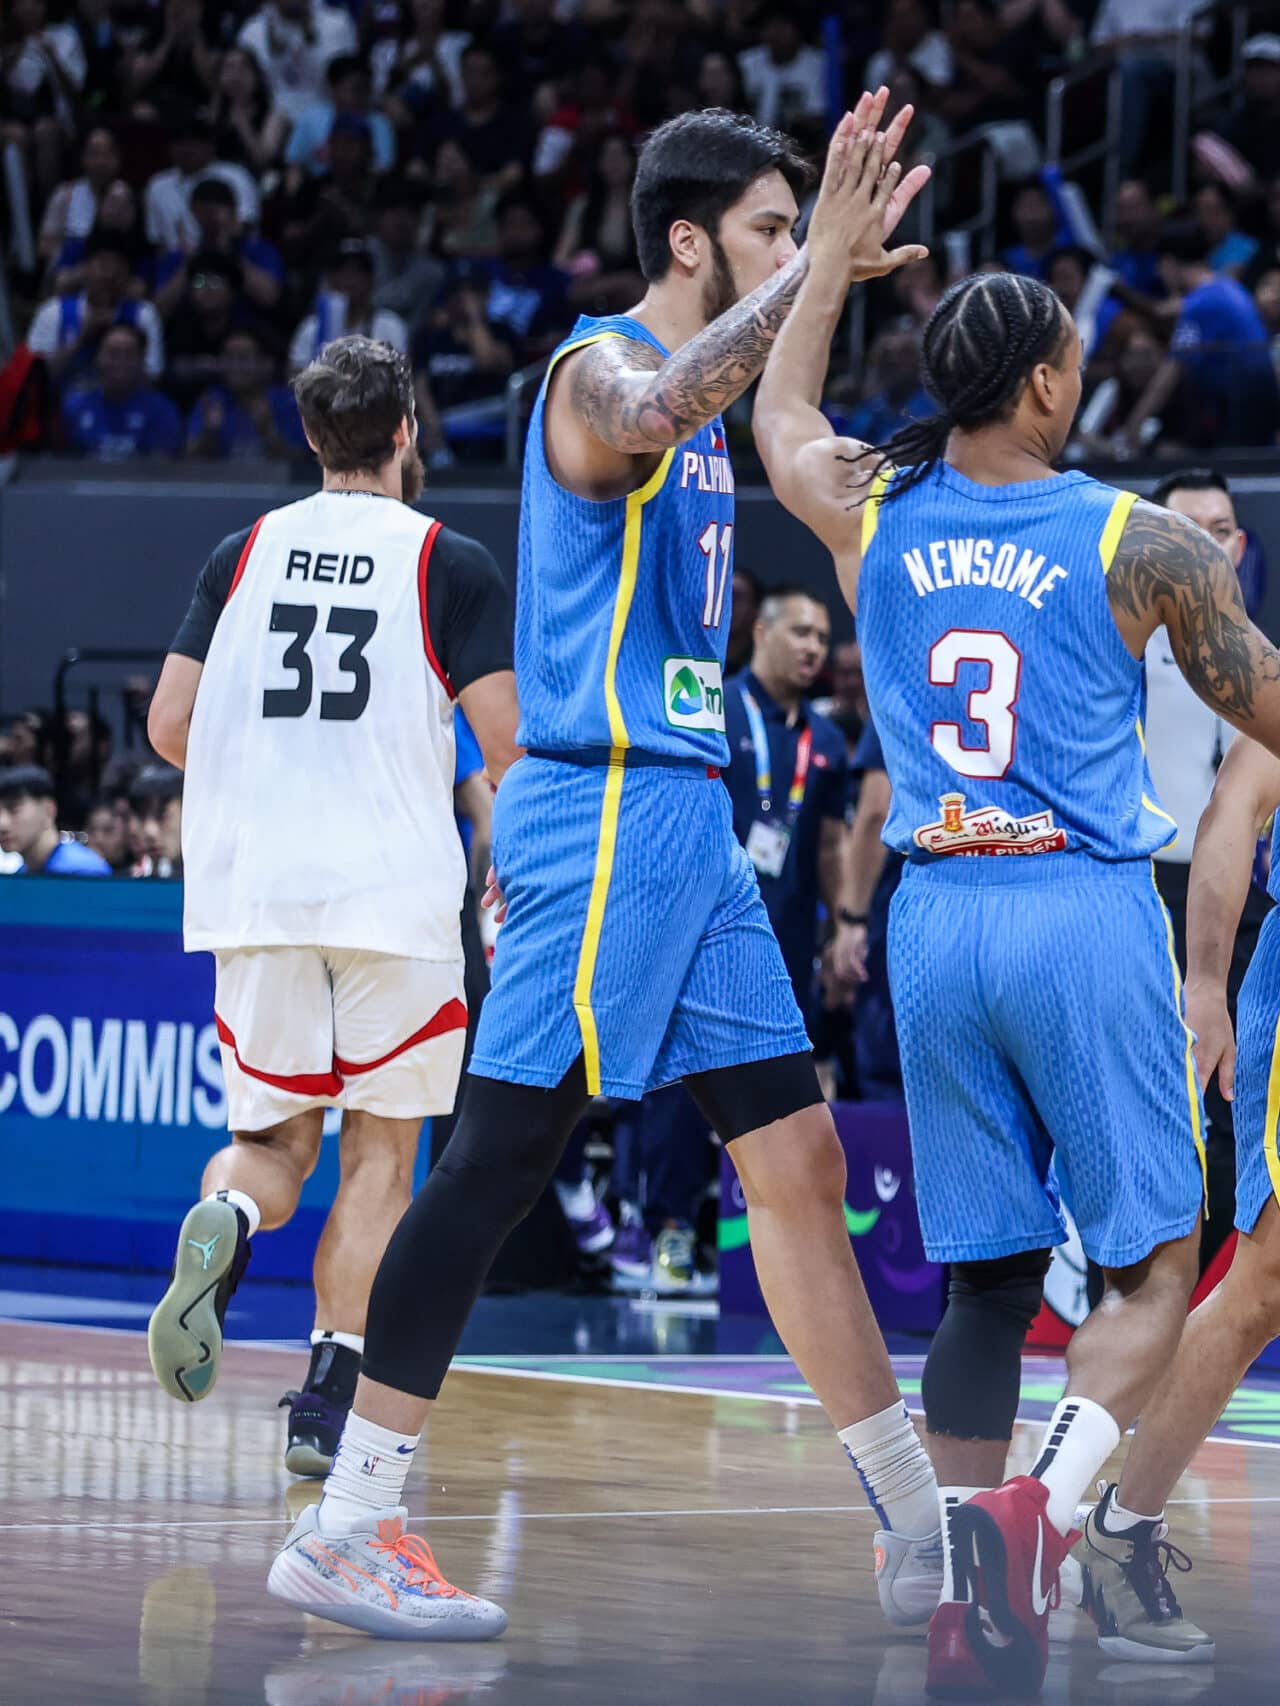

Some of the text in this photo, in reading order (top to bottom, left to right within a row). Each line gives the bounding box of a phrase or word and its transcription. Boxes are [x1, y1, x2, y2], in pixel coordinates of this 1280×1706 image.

[285, 549, 376, 586] REID
[696, 519, 734, 629] 11
[901, 537, 1070, 611] NEWSOME
[261, 602, 380, 723] 33
[927, 627, 1023, 781] 3
[972, 817, 1039, 839] Migu
